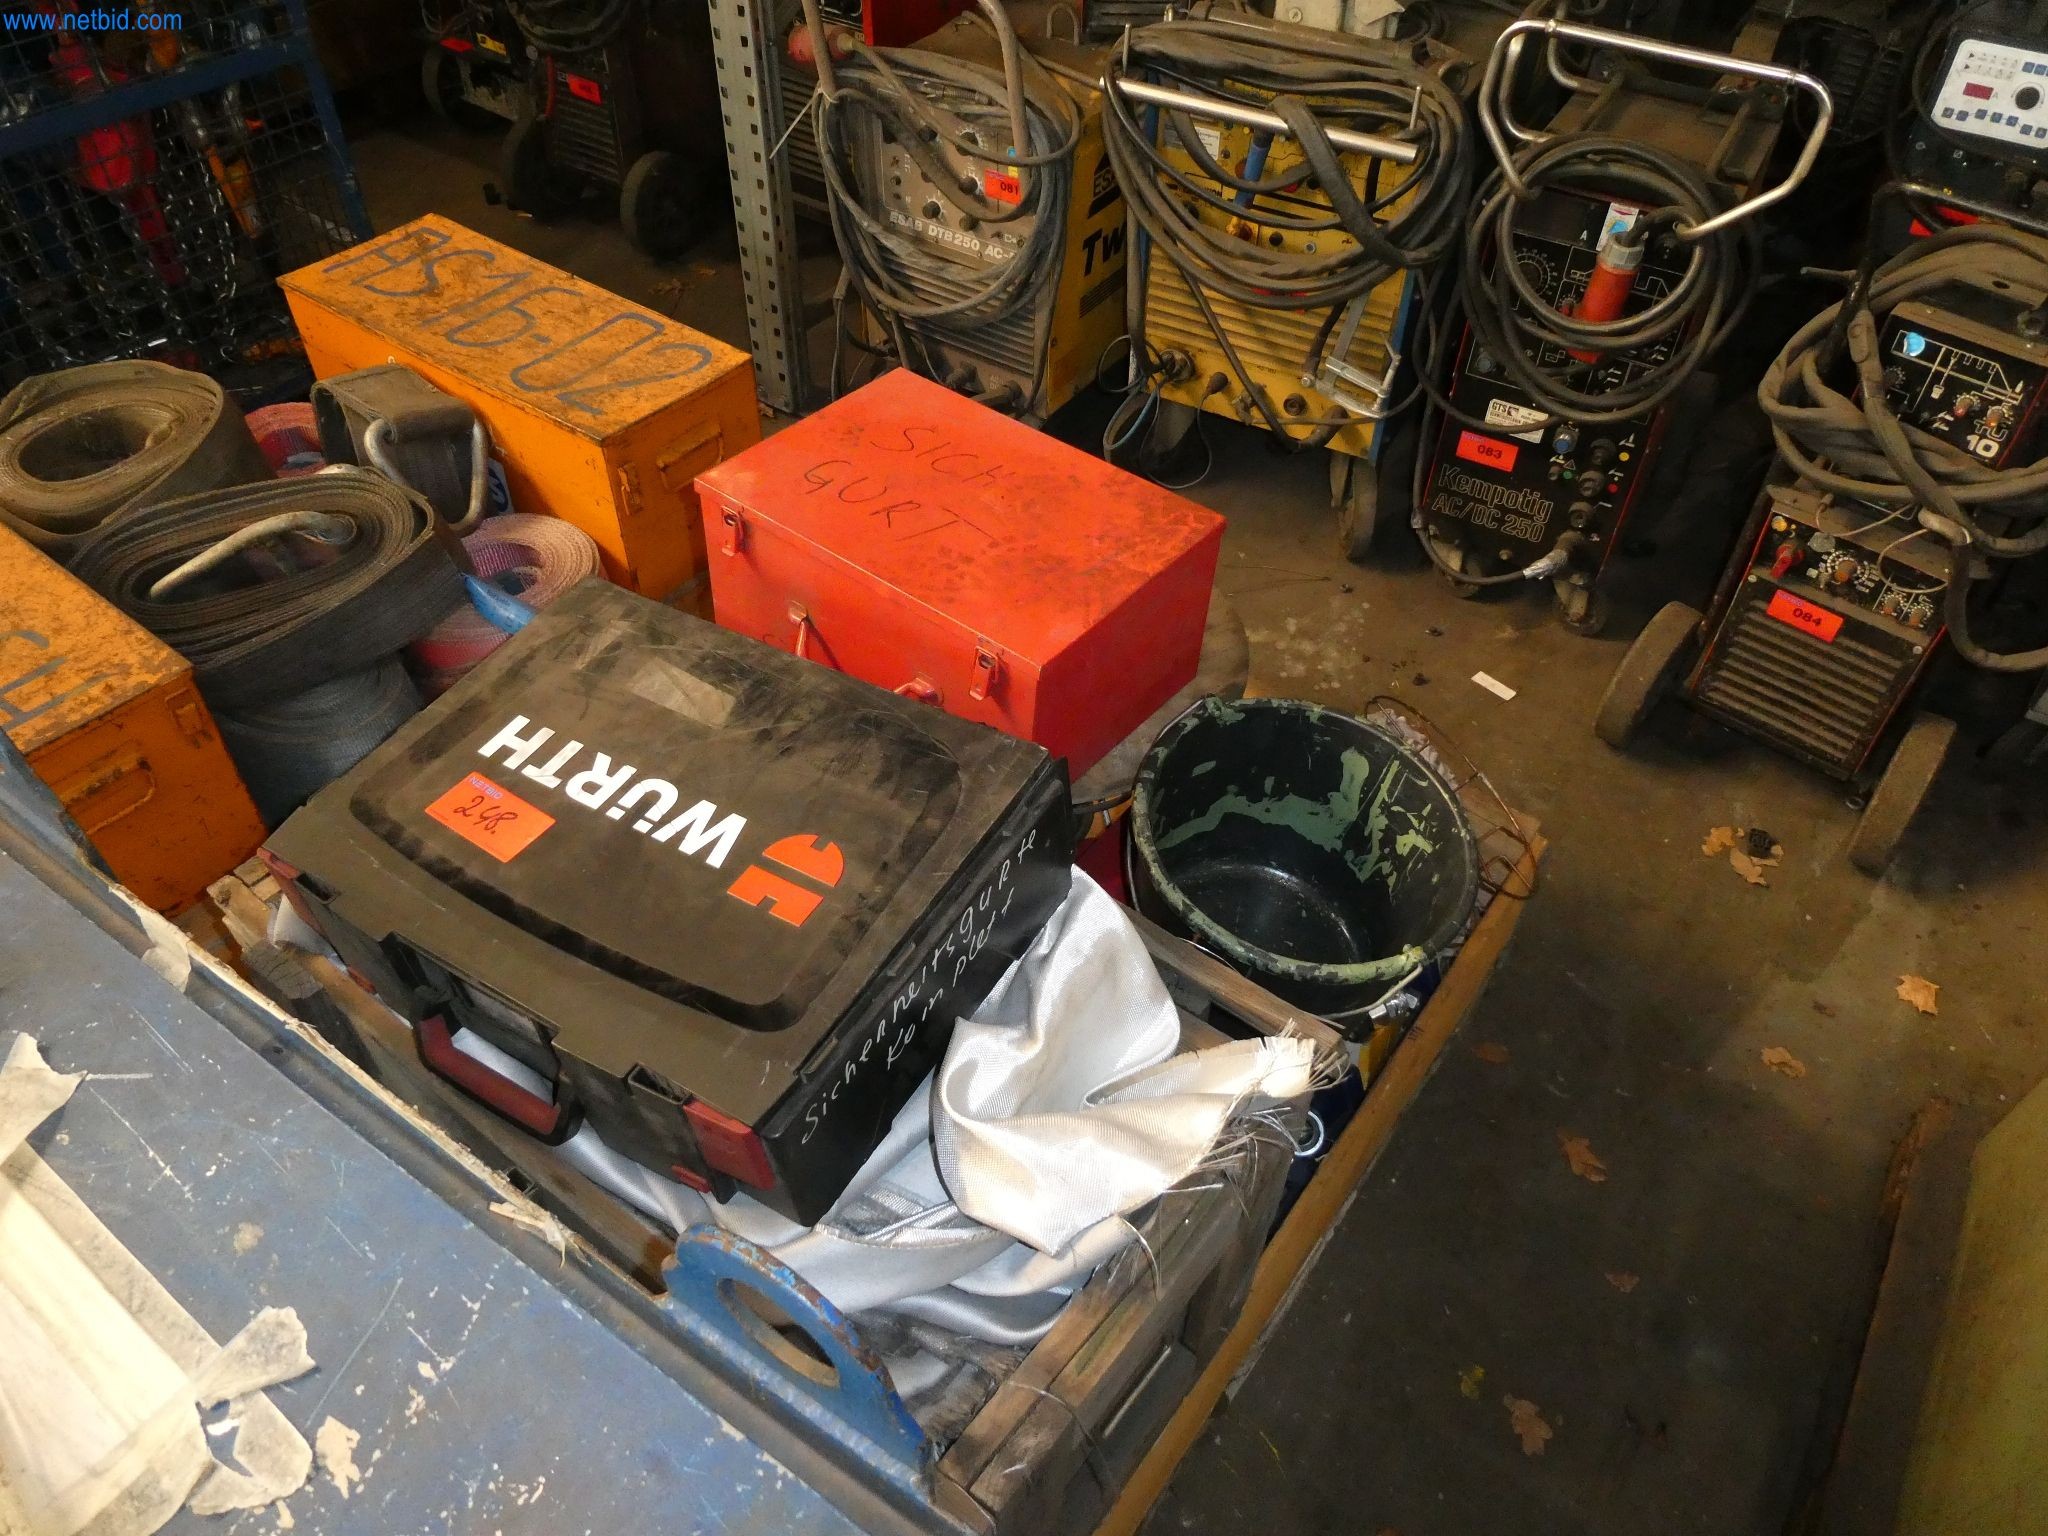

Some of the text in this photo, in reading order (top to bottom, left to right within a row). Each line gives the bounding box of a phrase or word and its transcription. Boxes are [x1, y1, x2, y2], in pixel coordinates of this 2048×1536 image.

[1000, 182, 1019, 196] 081
[888, 210, 923, 232] ESAB
[1491, 400, 1507, 412] GTS
[1477, 444, 1503, 460] 083
[1966, 434, 1999, 459] 10
[804, 460, 998, 541] GURT
[1438, 464, 1554, 524] Kempotig
[1431, 493, 1545, 543] AC/DC 250
[1792, 607, 1823, 627] 084
[478, 714, 748, 869] WÜRTH
